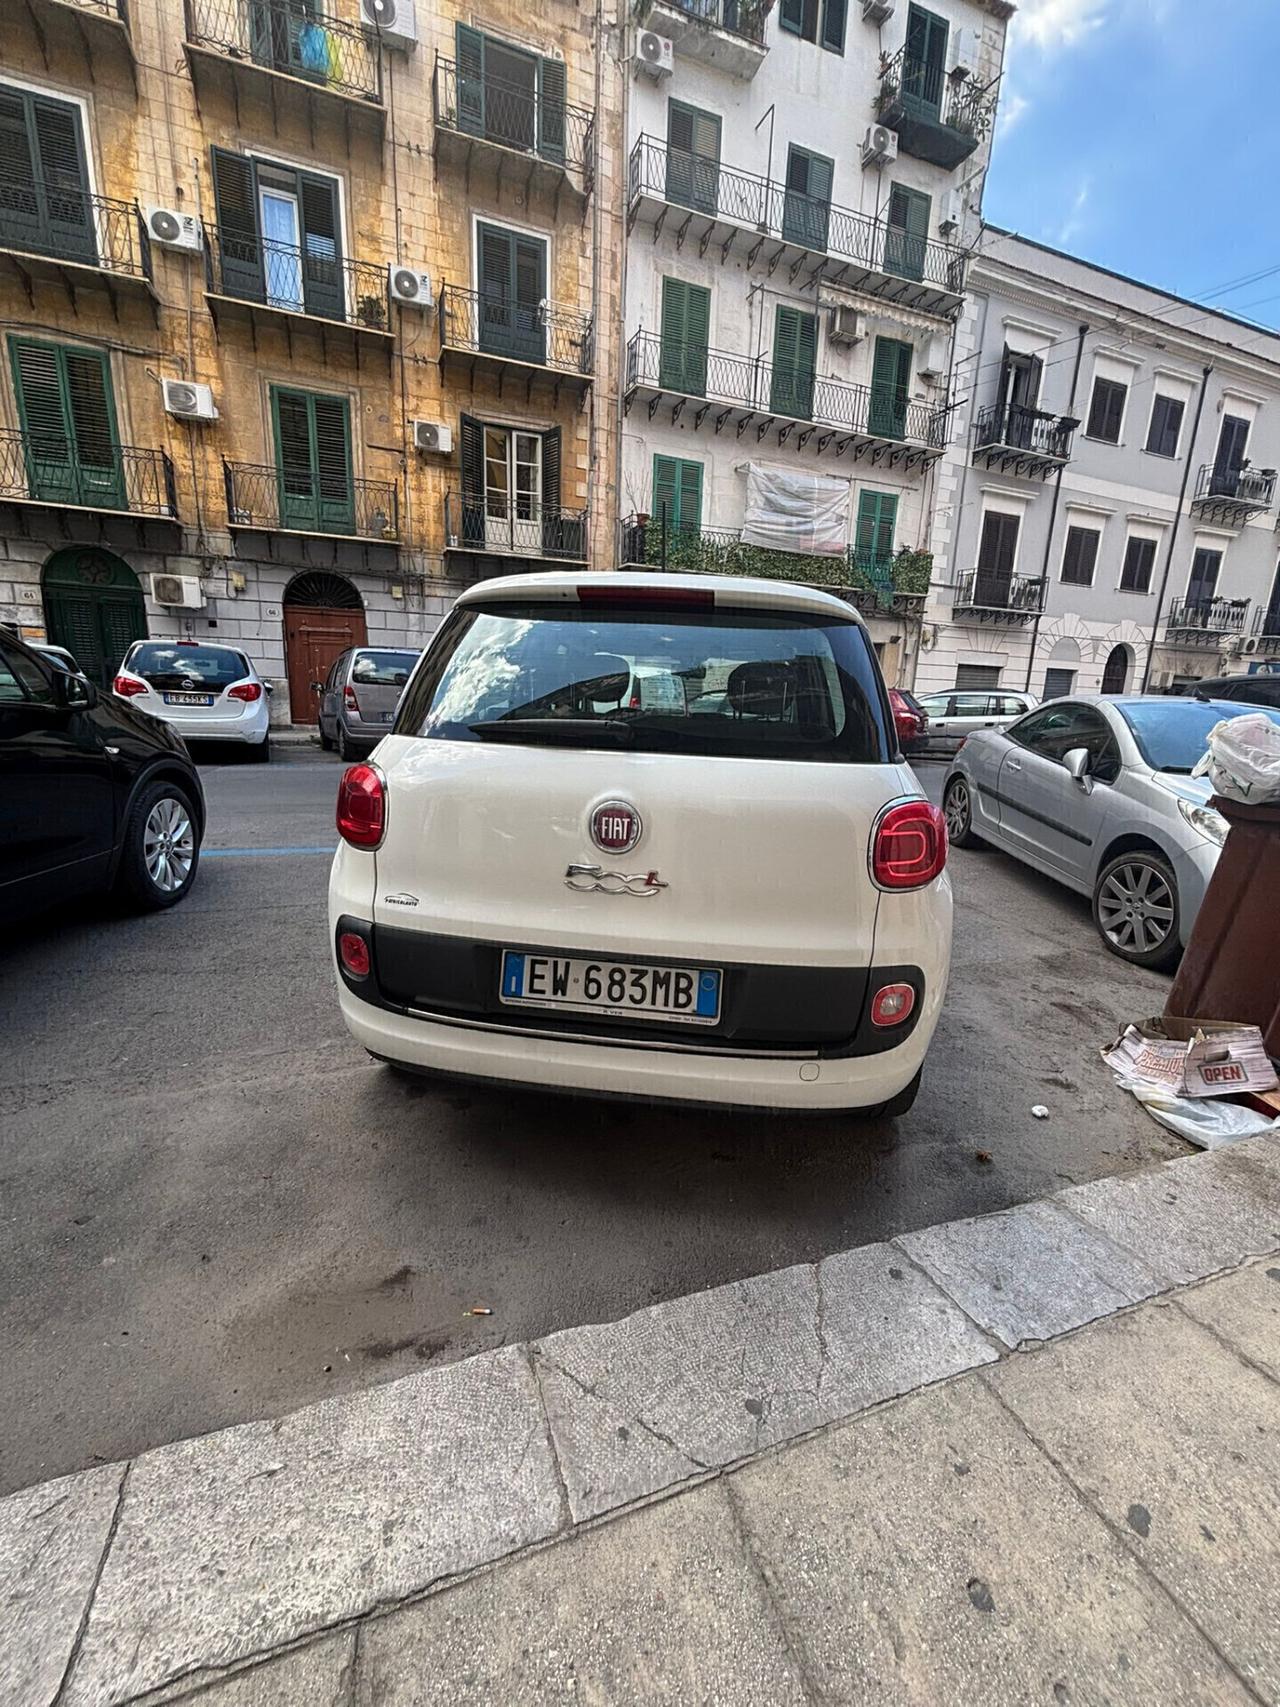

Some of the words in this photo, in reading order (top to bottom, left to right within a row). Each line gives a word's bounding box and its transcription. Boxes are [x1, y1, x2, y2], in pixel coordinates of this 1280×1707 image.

[601, 816, 631, 840] FIAT
[528, 958, 571, 997] EW
[583, 964, 694, 1009] 683MB
[1203, 1066, 1241, 1082] OPEN
